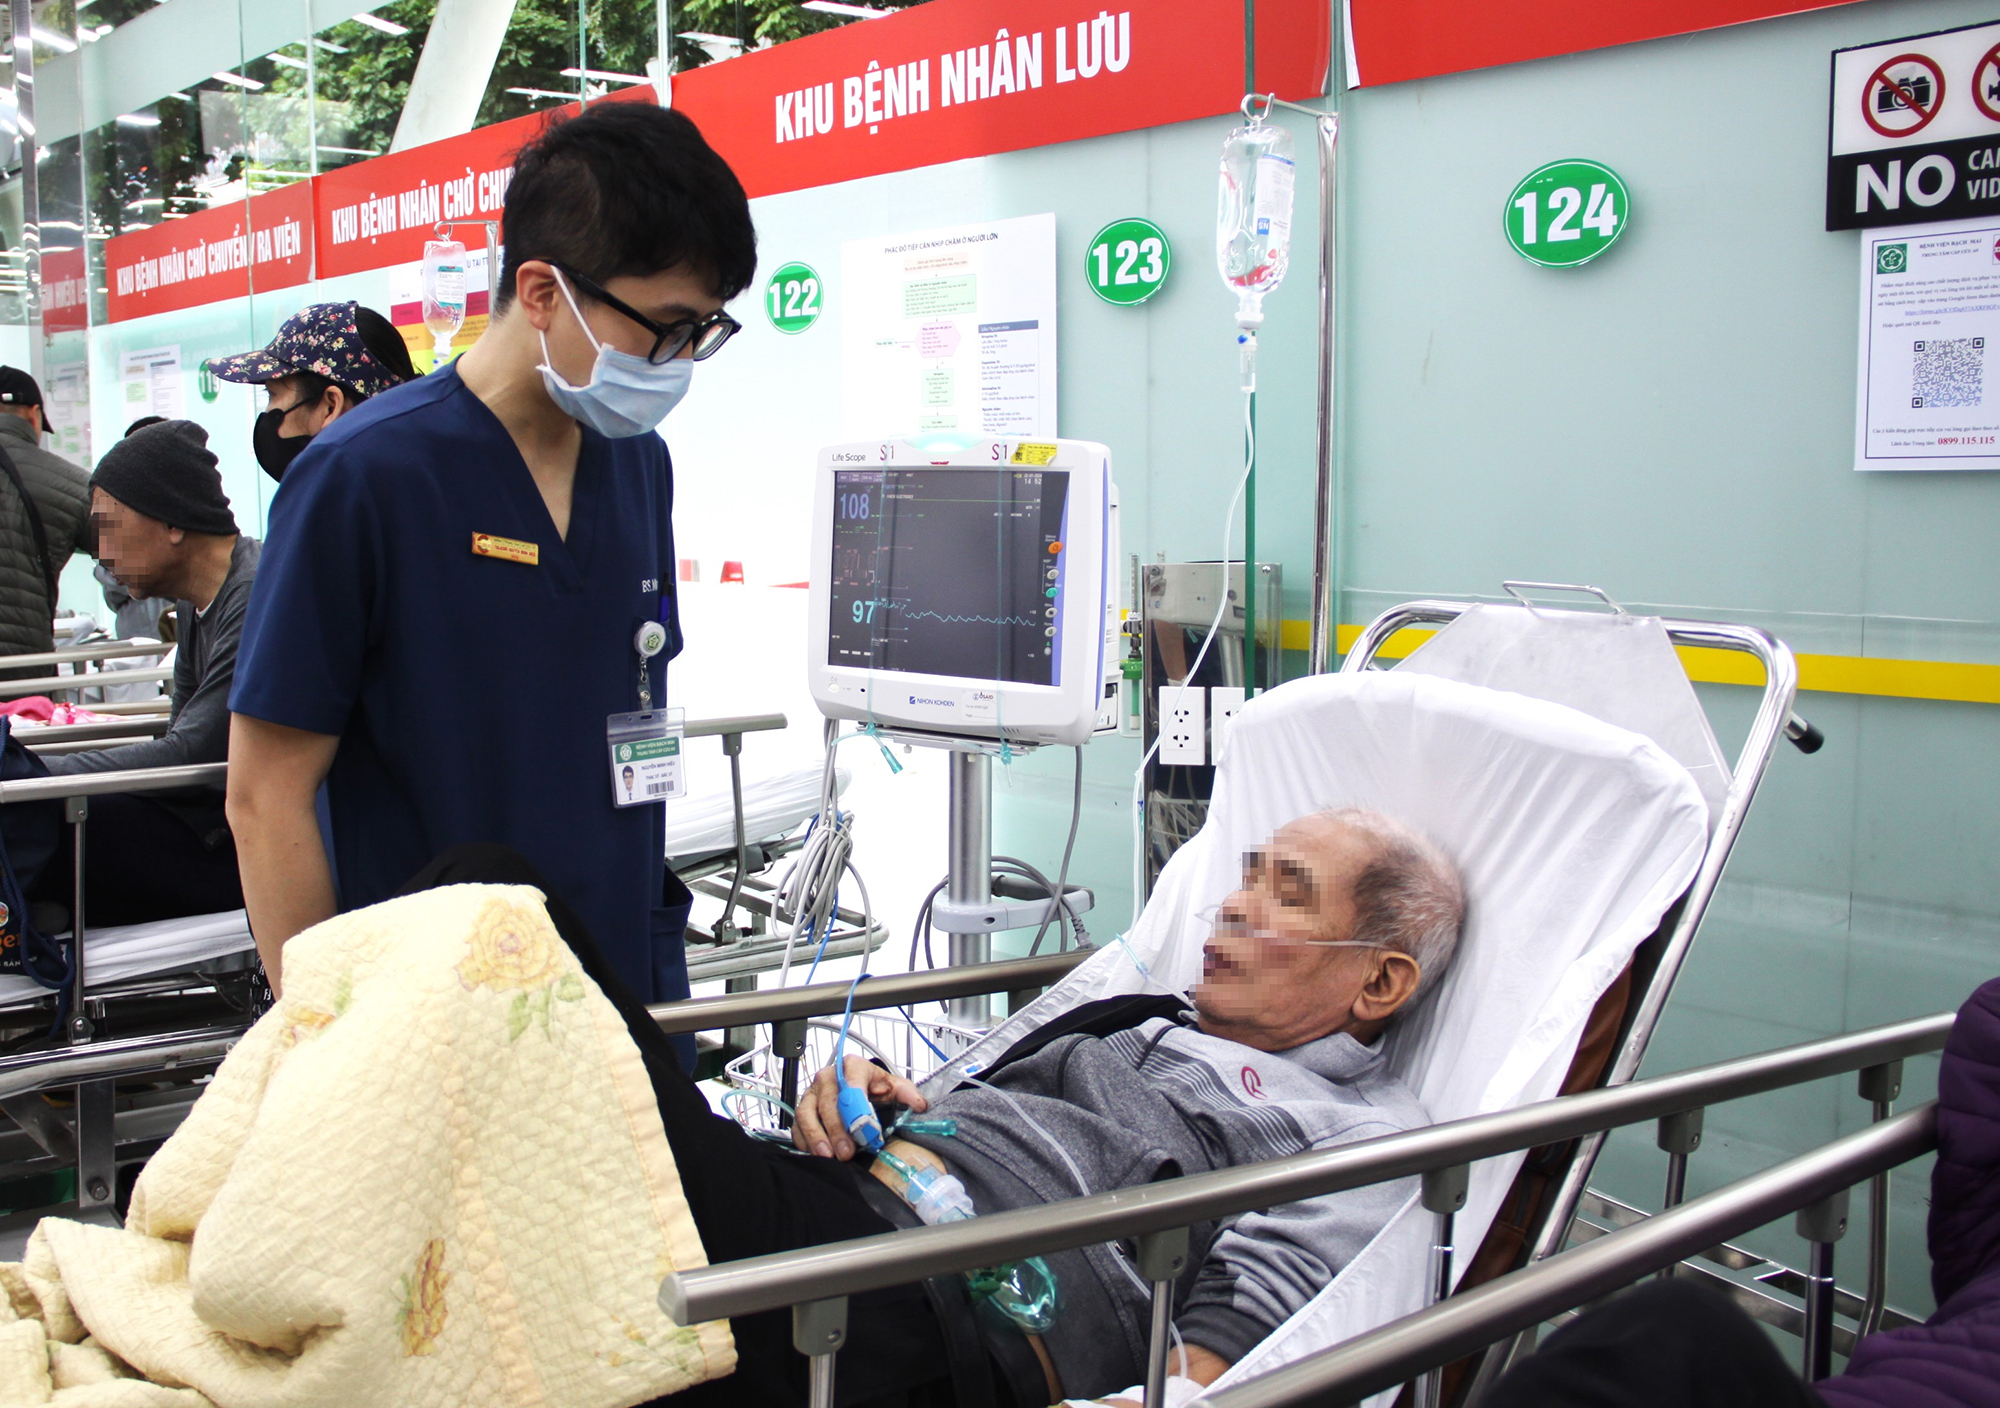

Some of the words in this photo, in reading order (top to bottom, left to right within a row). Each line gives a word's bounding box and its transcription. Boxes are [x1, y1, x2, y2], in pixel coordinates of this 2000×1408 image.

[775, 82, 834, 144] KHU
[843, 60, 930, 134] BỆNH
[941, 28, 1042, 107] NHÂN
[1056, 10, 1130, 84] LƯU
[332, 205, 358, 244] KHU
[360, 192, 397, 244] BỆNH
[399, 179, 440, 230] NHÂN
[443, 166, 475, 220] CHỜ
[1855, 154, 1956, 214] NO
[1515, 183, 1618, 244] 124
[116, 265, 134, 296] KHU
[135, 256, 159, 297] BỆNH
[159, 247, 186, 286] NHÂN
[186, 238, 206, 280] CHỜ
[258, 228, 272, 264] RA
[274, 216, 301, 264] VIỆN
[1092, 237, 1163, 287] 123
[769, 278, 820, 318] 122
[832, 453, 844, 462] Life
[845, 453, 866, 462] Scope
[1938, 436, 1995, 446] 0899.115.115
[840, 493, 870, 520] 108
[852, 600, 875, 624] 97
